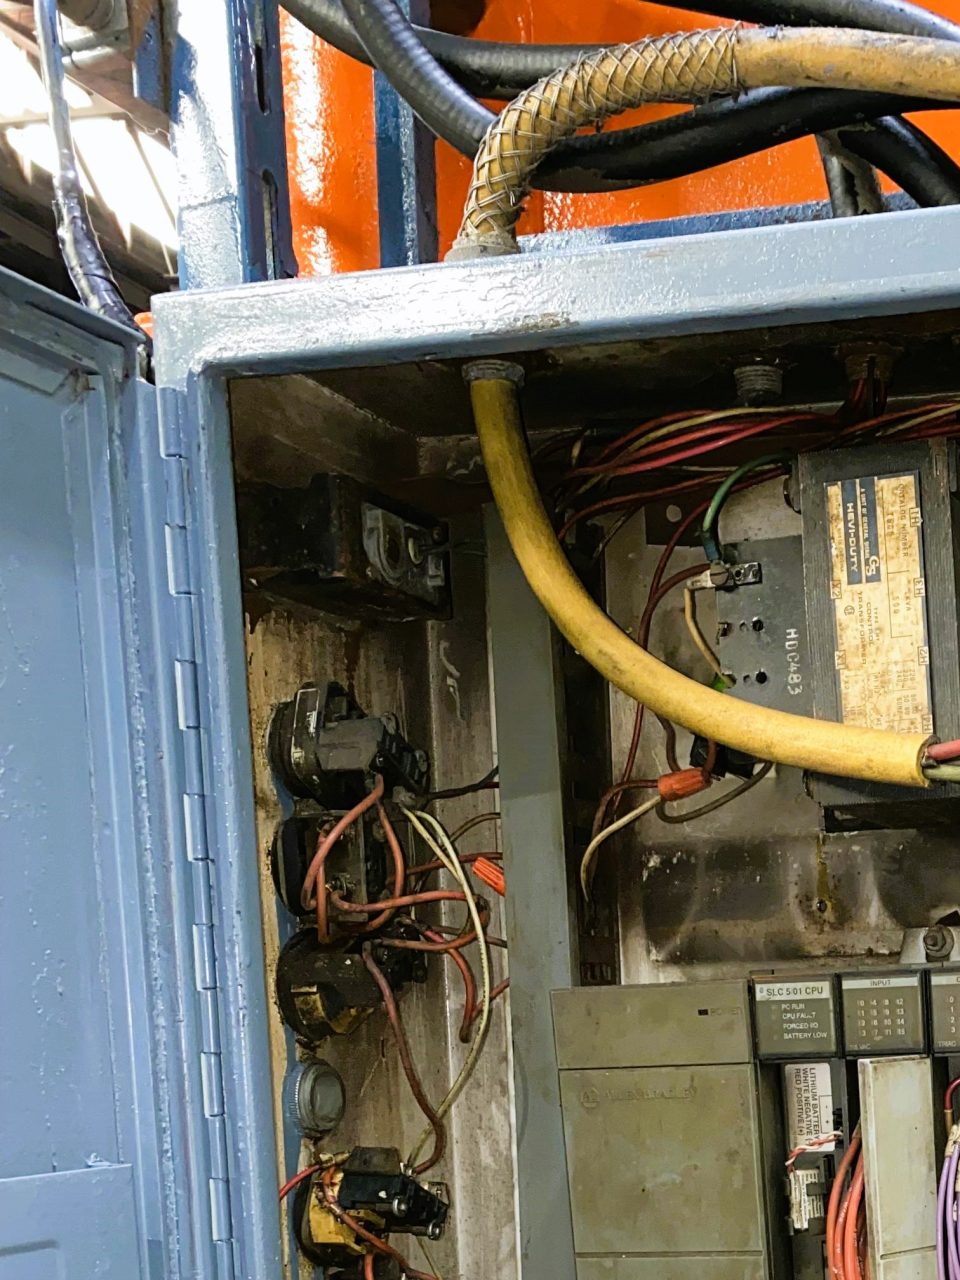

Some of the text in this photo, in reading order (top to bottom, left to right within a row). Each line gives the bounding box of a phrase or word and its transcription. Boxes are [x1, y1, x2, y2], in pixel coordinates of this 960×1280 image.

[846, 502, 859, 573] HEVI-DUTY
[902, 523, 910, 557] NUMBER
[831, 582, 841, 598] X2
[857, 591, 867, 664] TRANSFORMER
[866, 602, 874, 646] CONTROL
[785, 628, 803, 695] HDC483
[836, 651, 845, 668] X1
[919, 648, 928, 664] H2
[766, 987, 784, 997] SLC
[804, 986, 823, 995] CPU
[869, 979, 891, 987] INPUT
[812, 1031, 827, 1039] LOW
[794, 1068, 802, 1085] RED
[802, 1067, 810, 1093] WHITE
[795, 1087, 804, 1123] POSITIVE
[803, 1095, 812, 1137] NEGATIVE
[809, 1067, 820, 1139] LITHIUM BATTERY
